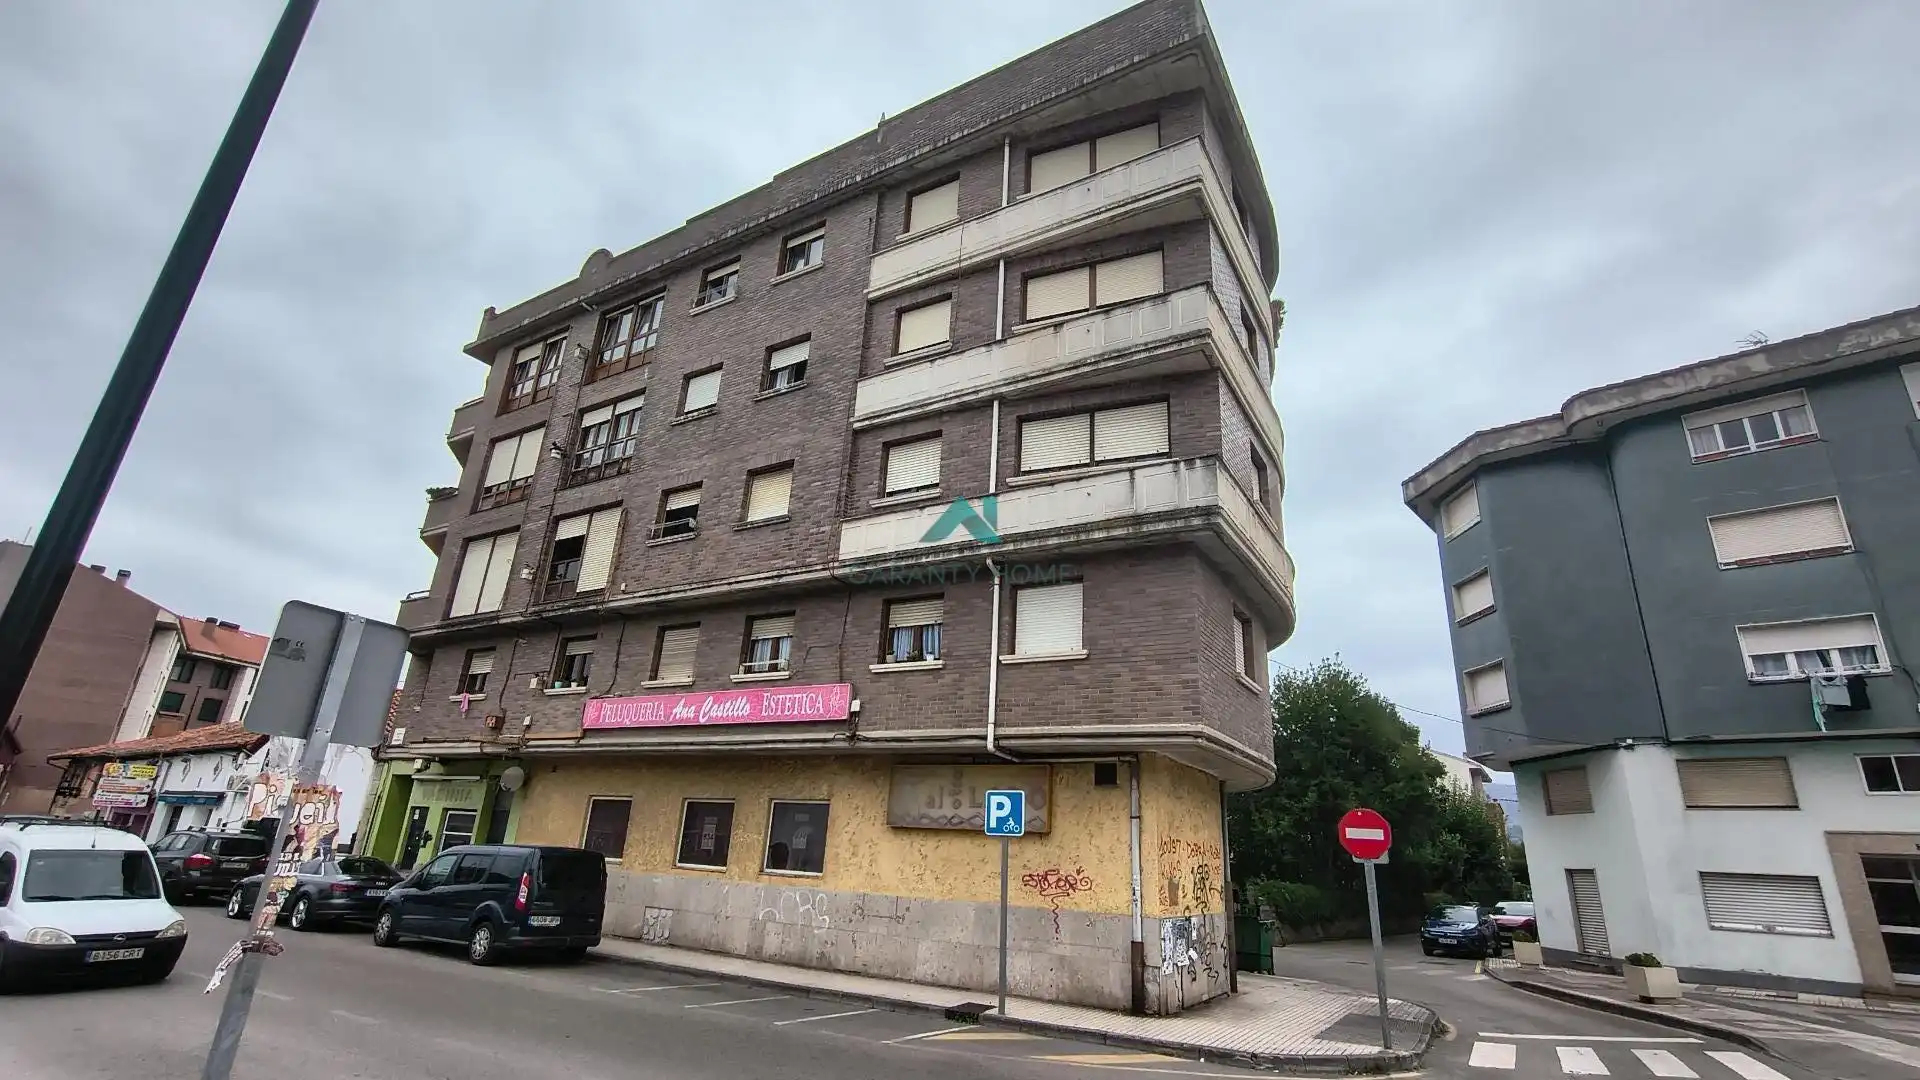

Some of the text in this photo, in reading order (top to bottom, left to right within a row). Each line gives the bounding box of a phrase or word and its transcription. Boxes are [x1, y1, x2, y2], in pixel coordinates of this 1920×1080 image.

[669, 698, 696, 721] Ana
[699, 695, 751, 723] Castillo
[989, 795, 1012, 828] P
